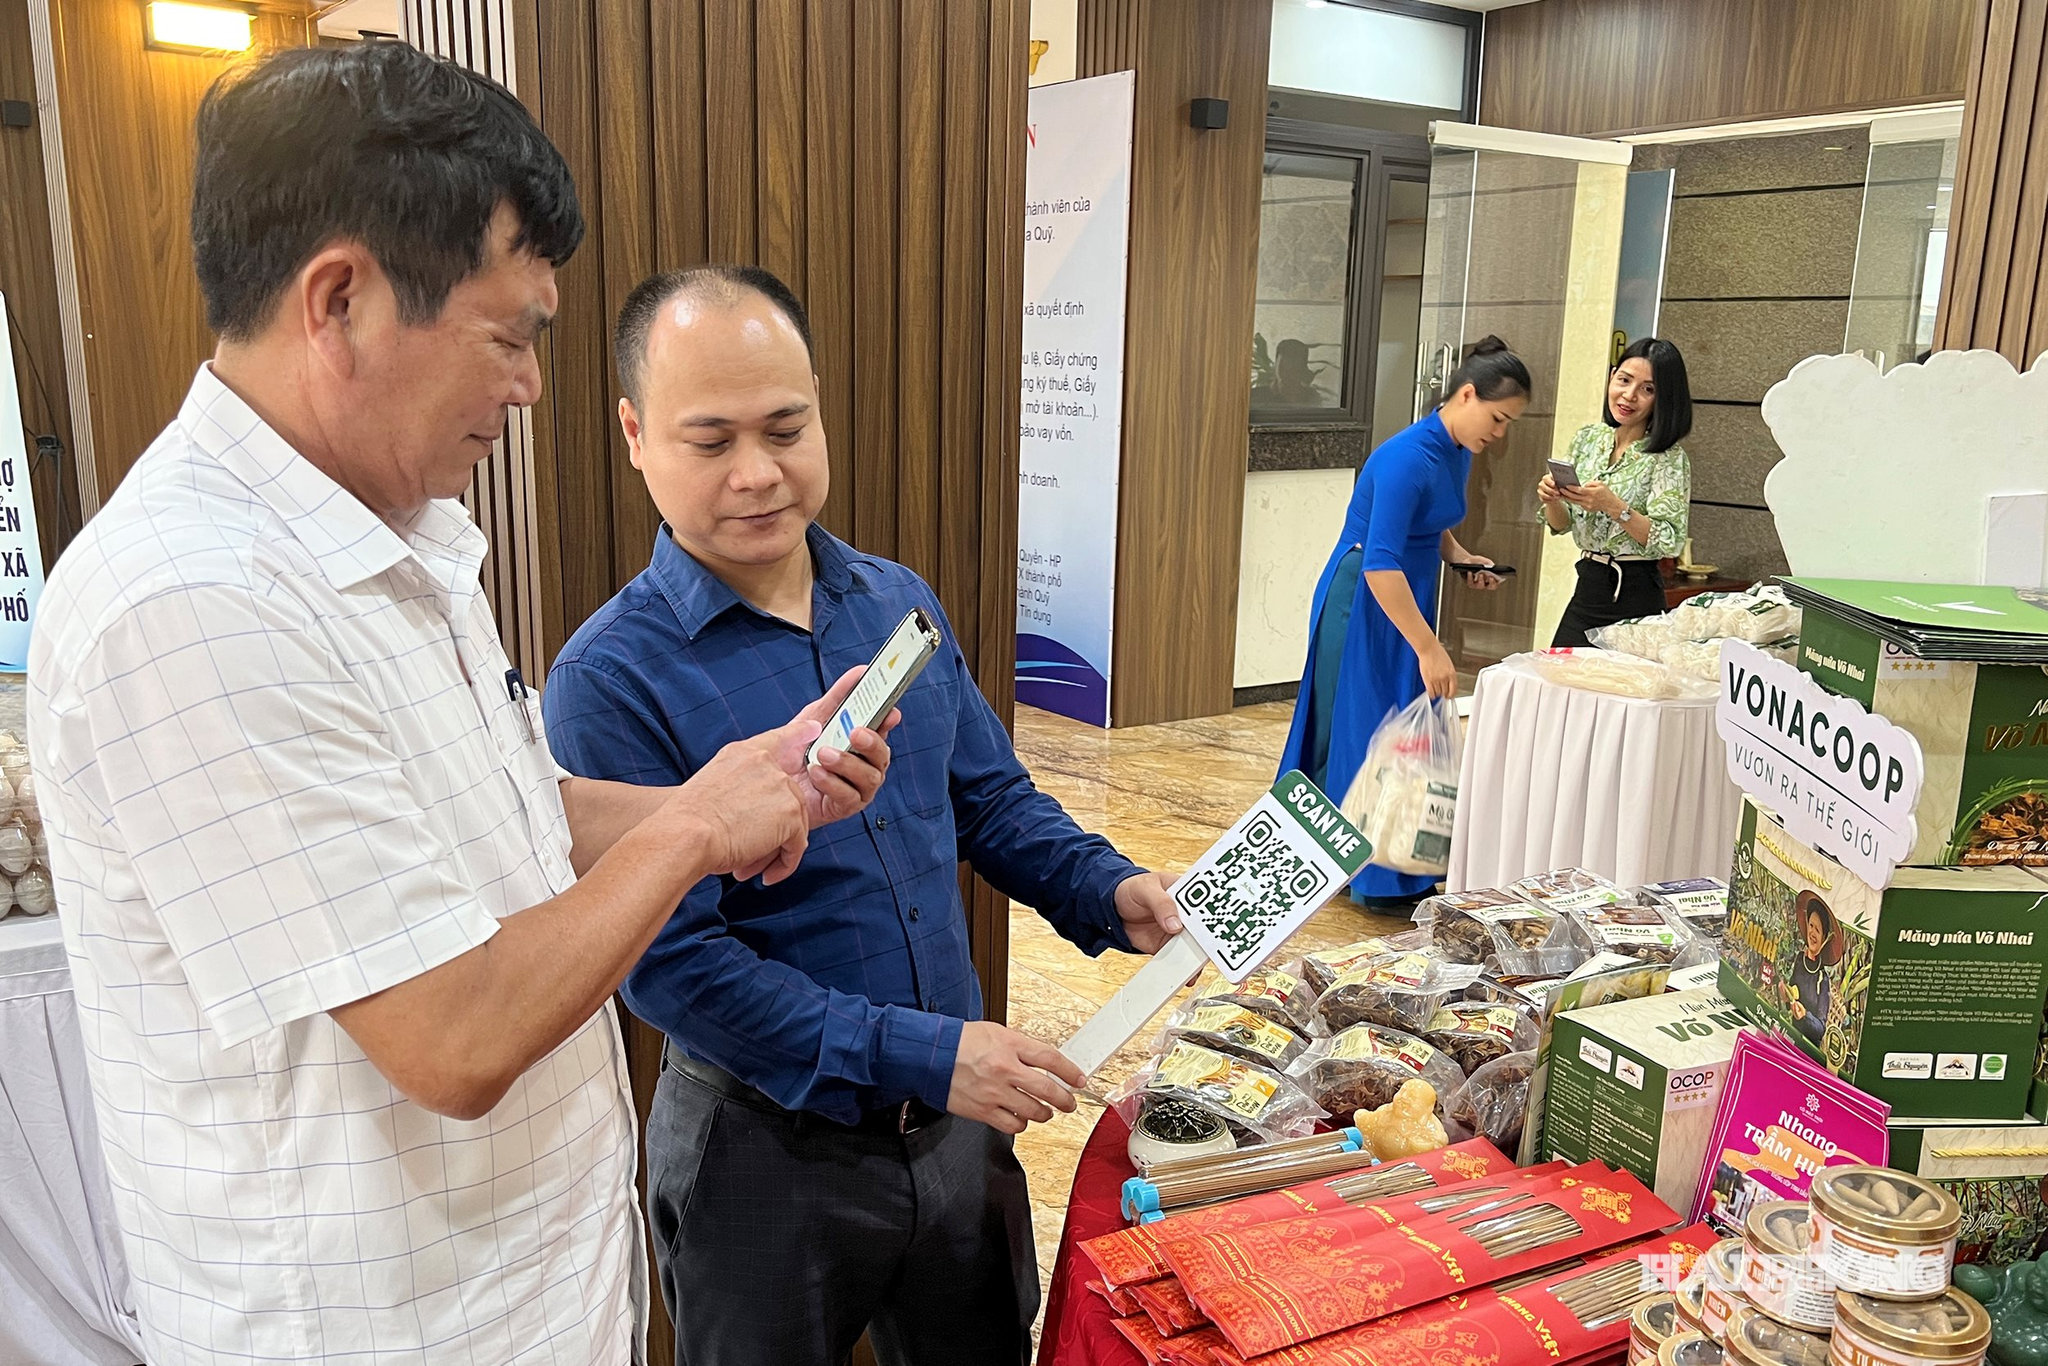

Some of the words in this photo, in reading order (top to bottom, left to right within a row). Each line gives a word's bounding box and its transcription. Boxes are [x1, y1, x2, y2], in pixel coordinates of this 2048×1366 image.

[1051, 198, 1071, 214] viên
[1072, 196, 1091, 212] của
[1024, 302, 1034, 315] xã
[1036, 298, 1062, 319] quyết
[1064, 301, 1084, 318] định
[1044, 348, 1065, 369] Giấy
[1067, 352, 1098, 370] chứng
[1036, 376, 1047, 393] ký
[1074, 375, 1096, 396] Giấy
[1043, 401, 1054, 415] tài
[1037, 427, 1053, 442] vay
[1030, 472, 1061, 489] doanh.
[4, 547, 30, 577] XÃ
[1049, 554, 1062, 567] HP
[1728, 661, 1903, 803] VONACOOP
[1734, 742, 1775, 786] VƯƠN
[1780, 773, 1799, 805] RA
[1807, 791, 1837, 830] THẾ
[1841, 819, 1879, 864] GIỚI
[1287, 783, 1338, 835] SCAN
[1327, 823, 1361, 859] ME
[1898, 929, 1941, 947] Măng
[1943, 930, 1972, 944] nứa
[1975, 931, 1994, 945] Võ
[1996, 931, 2034, 946] Nhai
[1670, 1071, 1714, 1090] OCOP
[1743, 1123, 1791, 1162] TRẦM
[1778, 1110, 1838, 1158] Nhang
